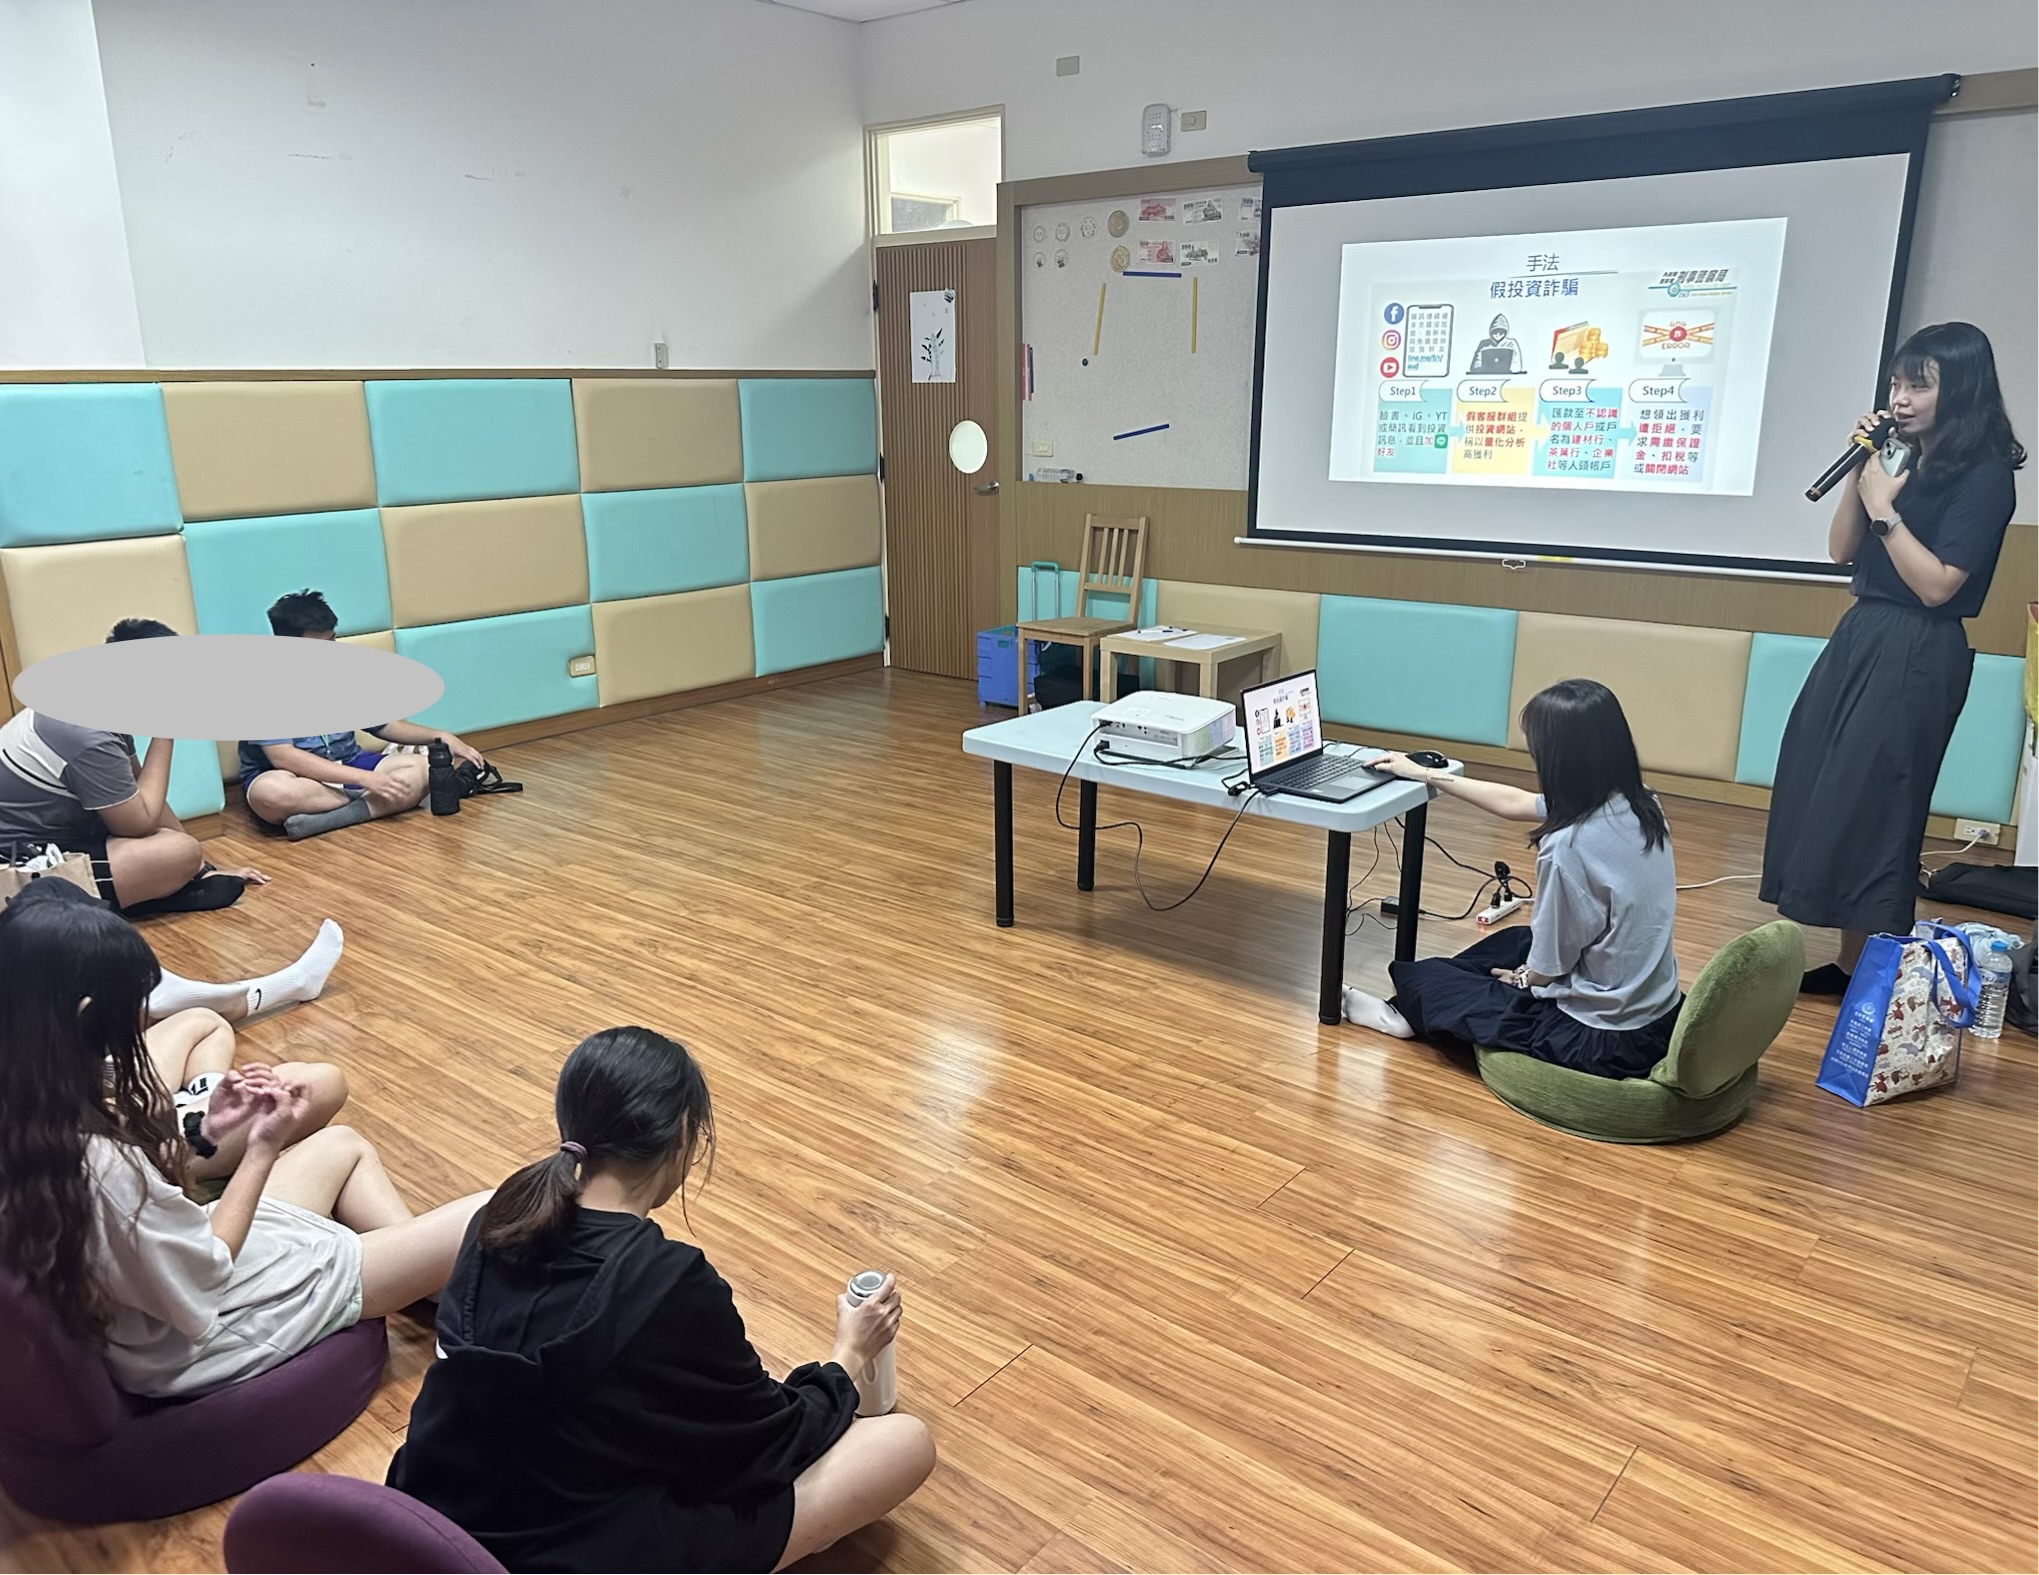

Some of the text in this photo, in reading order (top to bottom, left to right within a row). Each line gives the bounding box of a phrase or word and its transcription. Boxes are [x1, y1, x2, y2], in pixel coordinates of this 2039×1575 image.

[1526, 253, 1560, 272] 手法
[1490, 278, 1579, 299] 假投資詐騙
[1390, 386, 1416, 397] Step1
[1469, 386, 1497, 397] Step2
[1552, 386, 1582, 397] Step3
[1642, 386, 1674, 398] Step4
[1466, 411, 1528, 422] 假客服群組提
[1552, 407, 1618, 418] 匯款至不認識
[1639, 409, 1704, 421] 想領出獲利
[1378, 423, 1446, 433] 或簡訊看到投資
[1551, 421, 1617, 431] 的個人戶或戶
[1464, 436, 1526, 447] 稱以量化分析
[1637, 436, 1700, 448] 求需繳保證
[1376, 447, 1395, 457] 好友
[1463, 449, 1493, 459] 高獲利
[1547, 460, 1611, 471] 社等人頭帳戶
[1633, 463, 1690, 475] 或關閉網站
